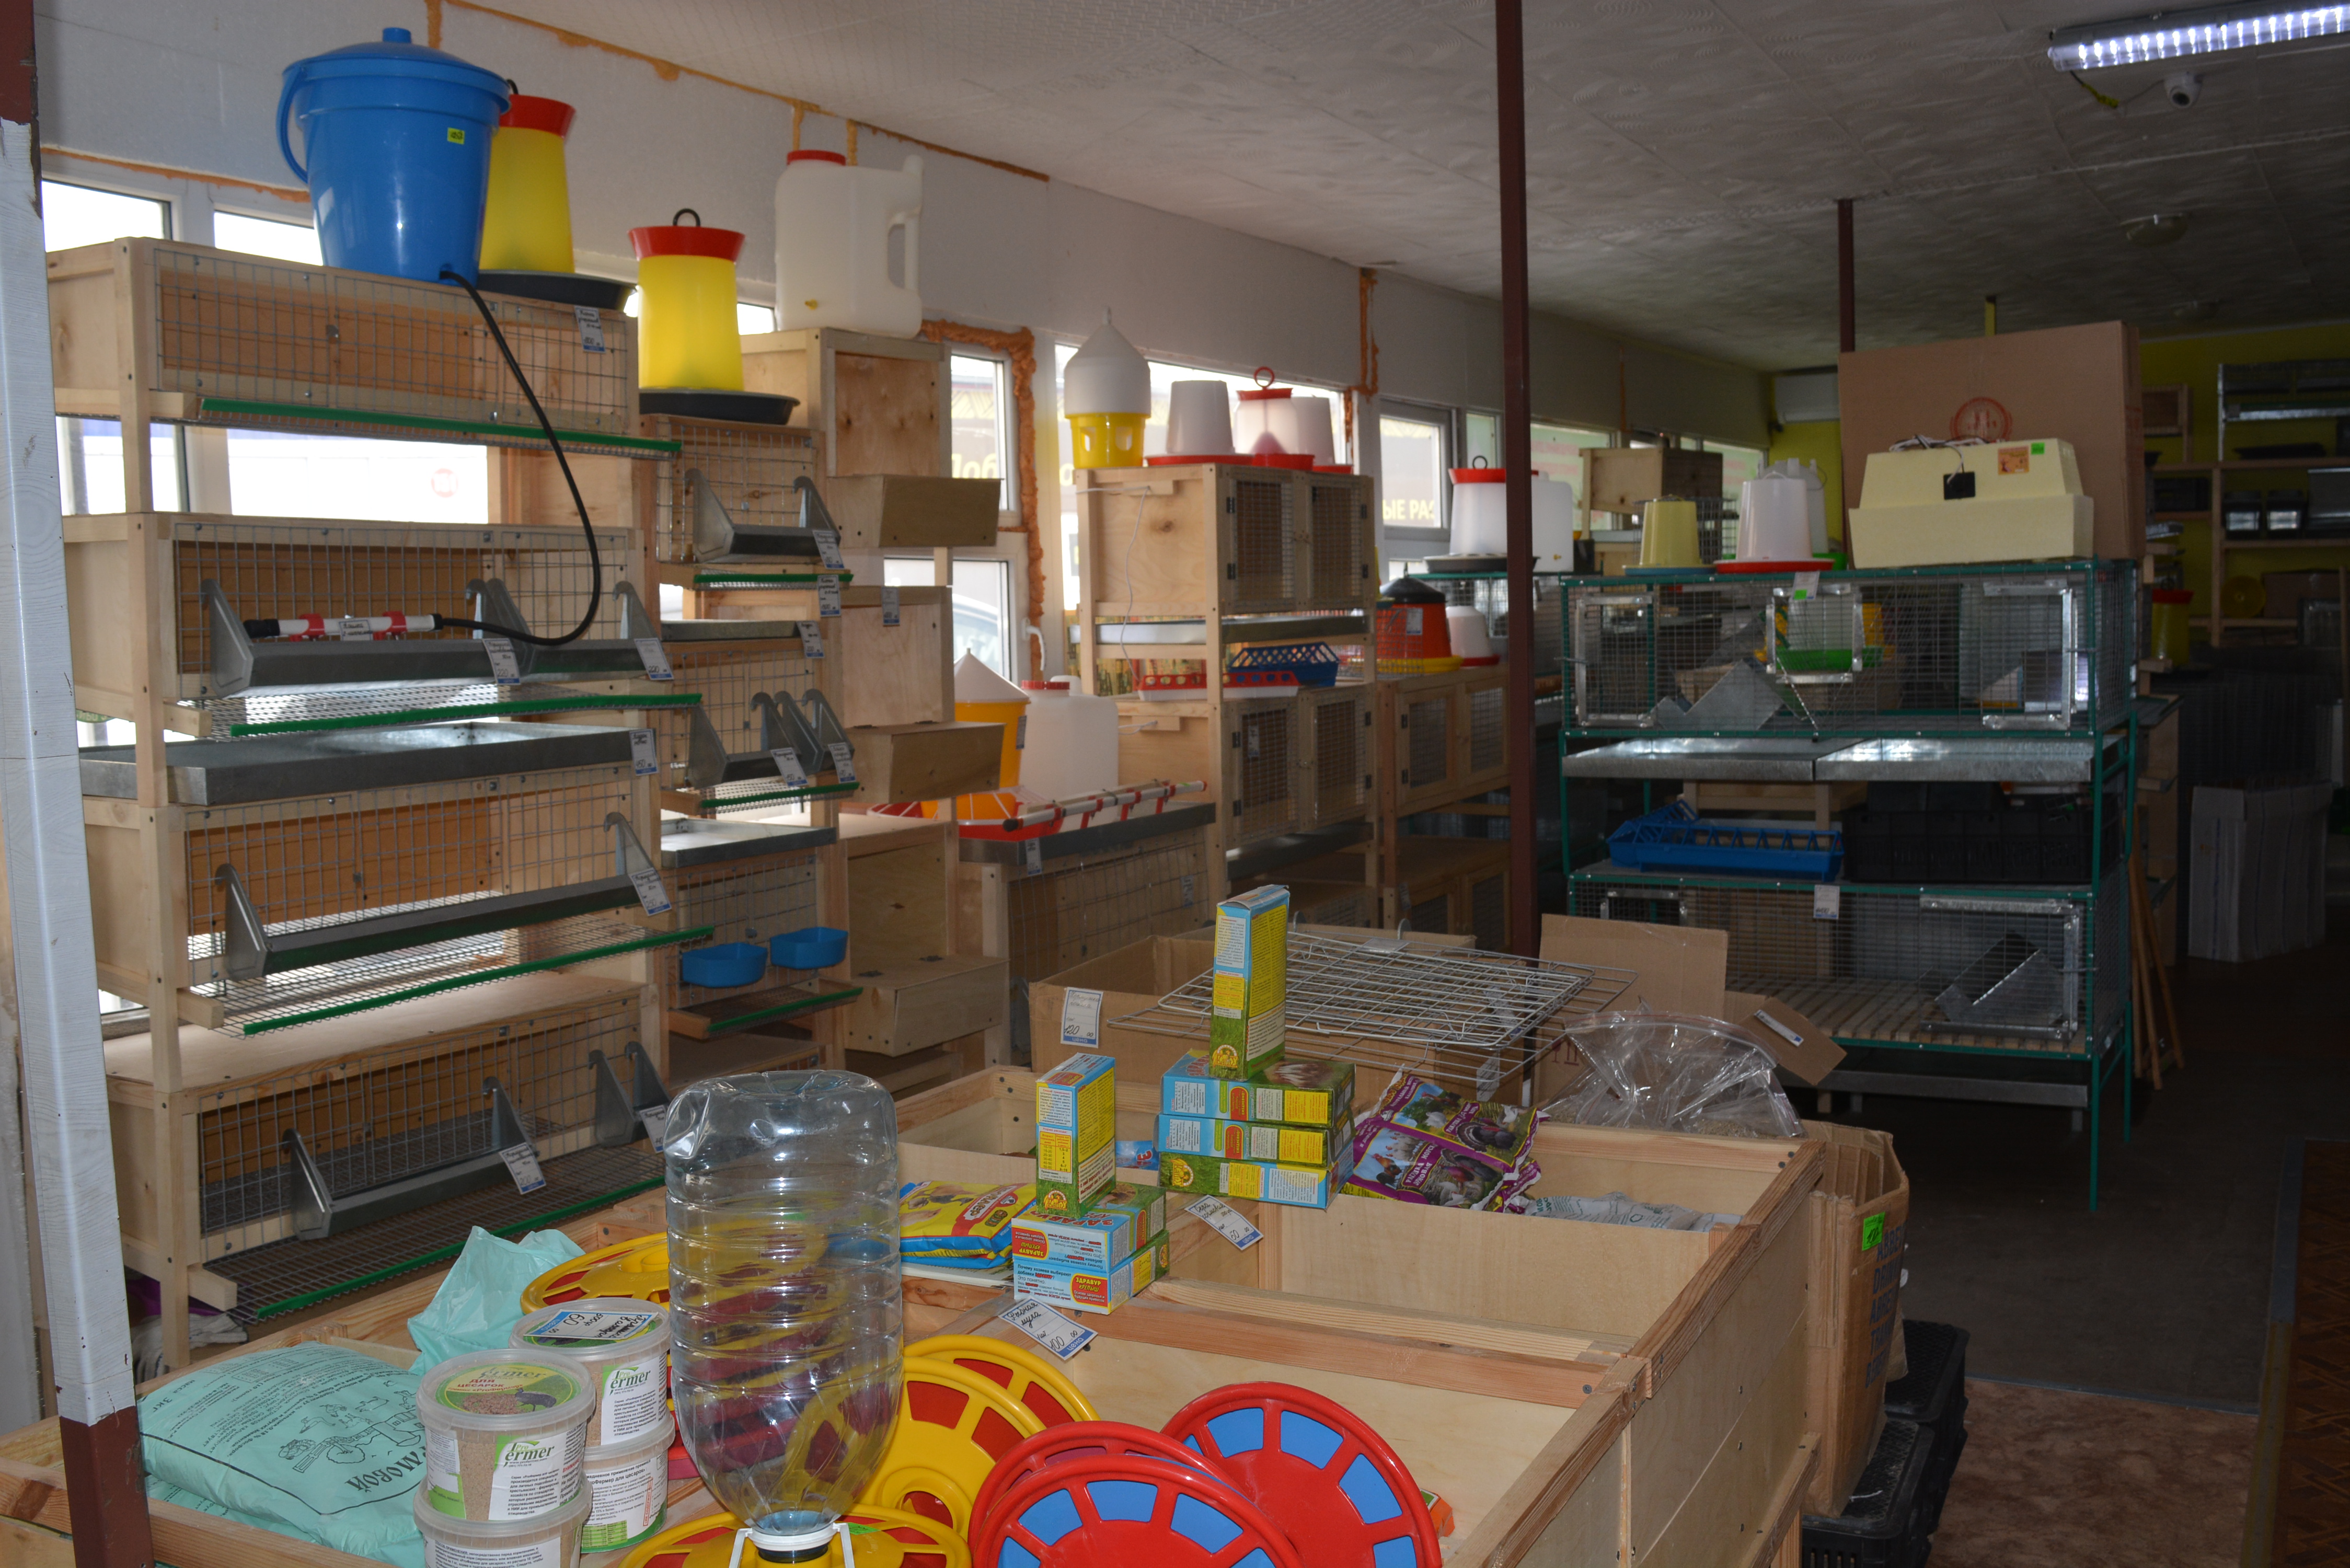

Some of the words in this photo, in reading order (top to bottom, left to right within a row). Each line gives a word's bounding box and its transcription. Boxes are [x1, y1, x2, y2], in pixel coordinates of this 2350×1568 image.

[1064, 1024, 1079, 1035] 120
[1229, 1229, 1239, 1240] 50
[1242, 1235, 1254, 1243] цена
[1076, 1277, 1101, 1286] ЗДРАВУР
[1007, 1302, 1038, 1321] Рыбная
[563, 1313, 585, 1326] 60
[1051, 1336, 1065, 1351] 100
[1067, 1337, 1084, 1351] цена
[172, 1377, 195, 1396] масса
[150, 1395, 172, 1414] 3кг
[610, 1467, 635, 1475] применение
